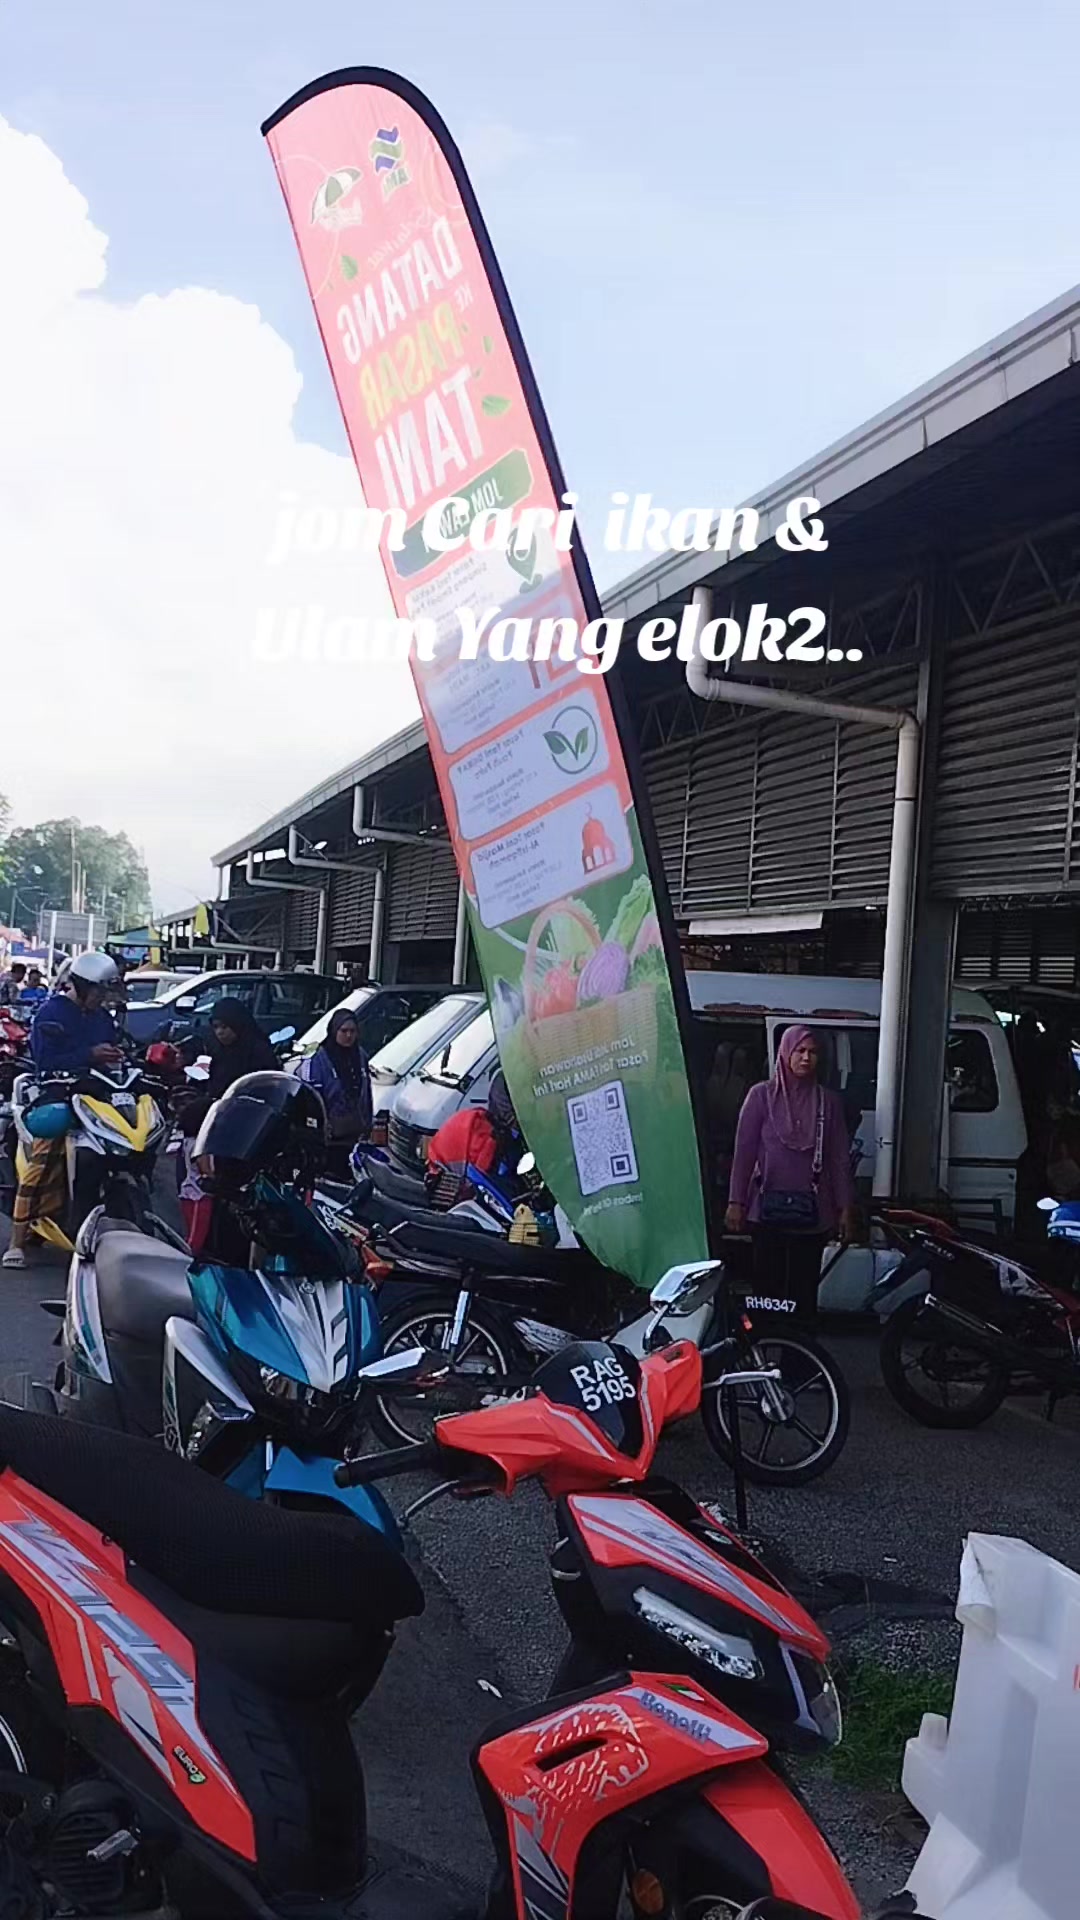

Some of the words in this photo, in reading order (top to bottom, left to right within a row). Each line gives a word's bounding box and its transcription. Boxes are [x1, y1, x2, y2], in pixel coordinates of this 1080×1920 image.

[745, 1296, 797, 1313] RH6347
[570, 1357, 624, 1389] RAG
[581, 1376, 636, 1411] 5195
